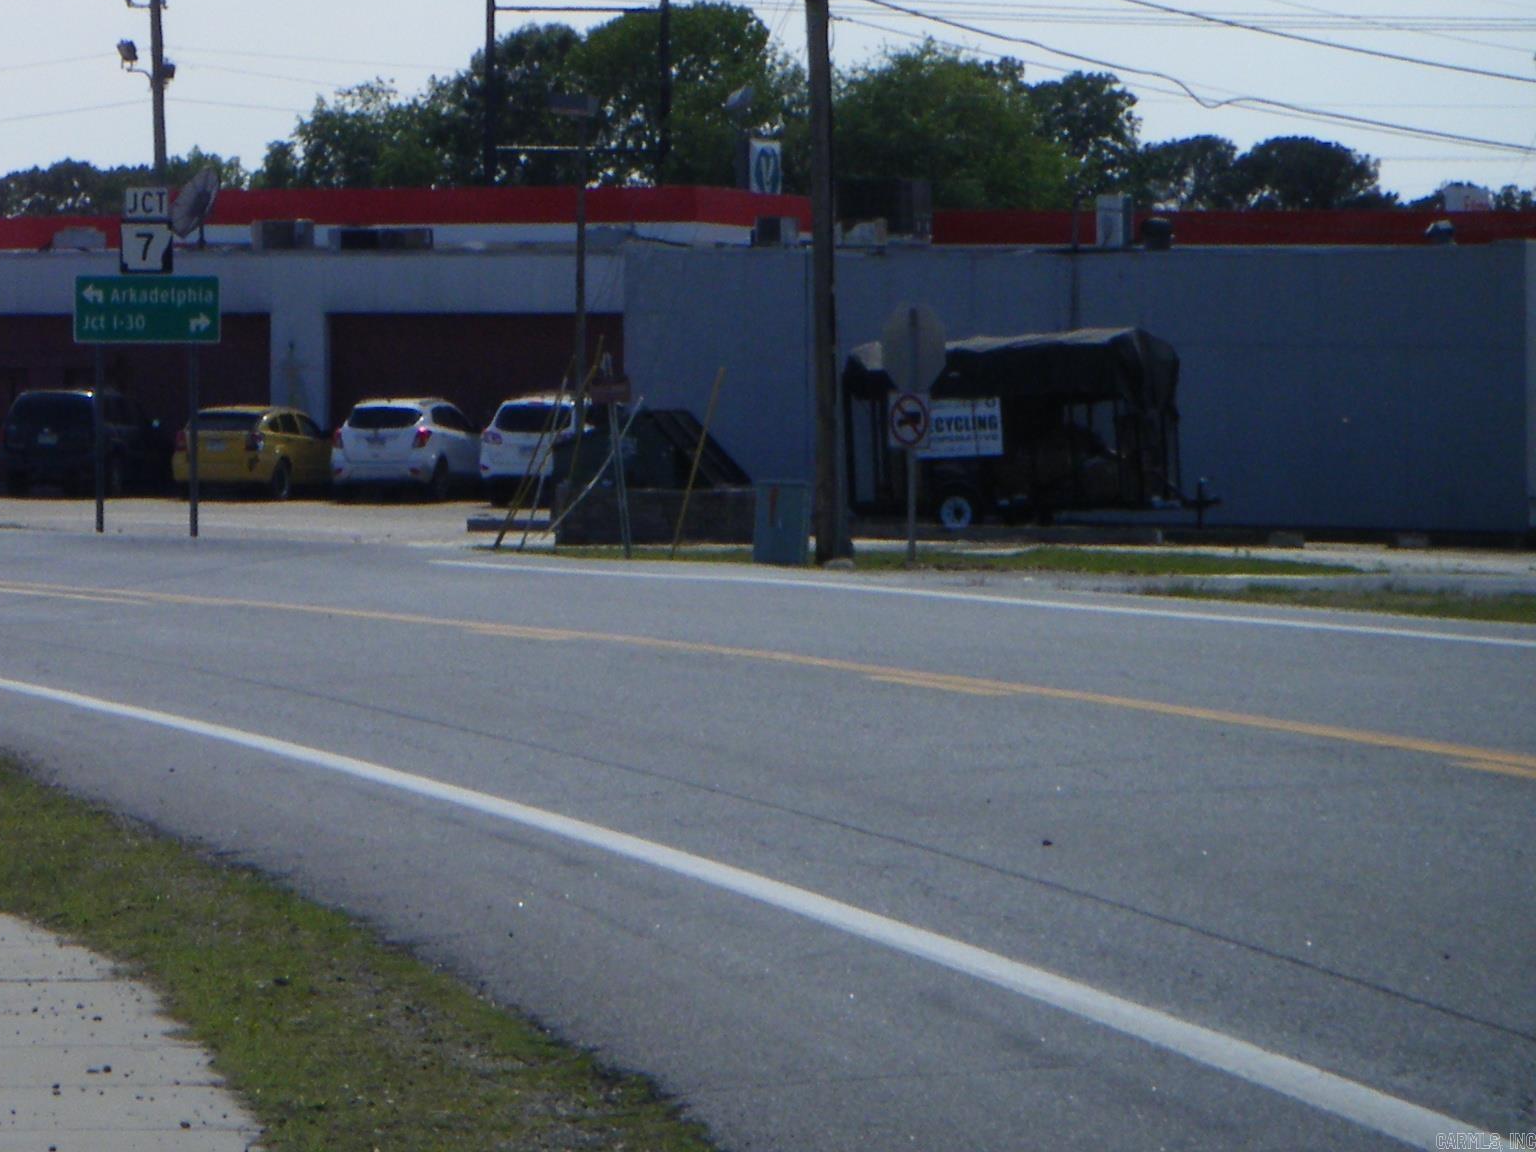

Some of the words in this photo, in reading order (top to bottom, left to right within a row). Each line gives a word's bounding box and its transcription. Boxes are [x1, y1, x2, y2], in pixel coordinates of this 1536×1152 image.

[128, 190, 166, 214] JCT
[135, 232, 155, 261] 7
[110, 285, 214, 307] Arkadelphia
[82, 314, 106, 330] Jct
[113, 314, 145, 330] I-30
